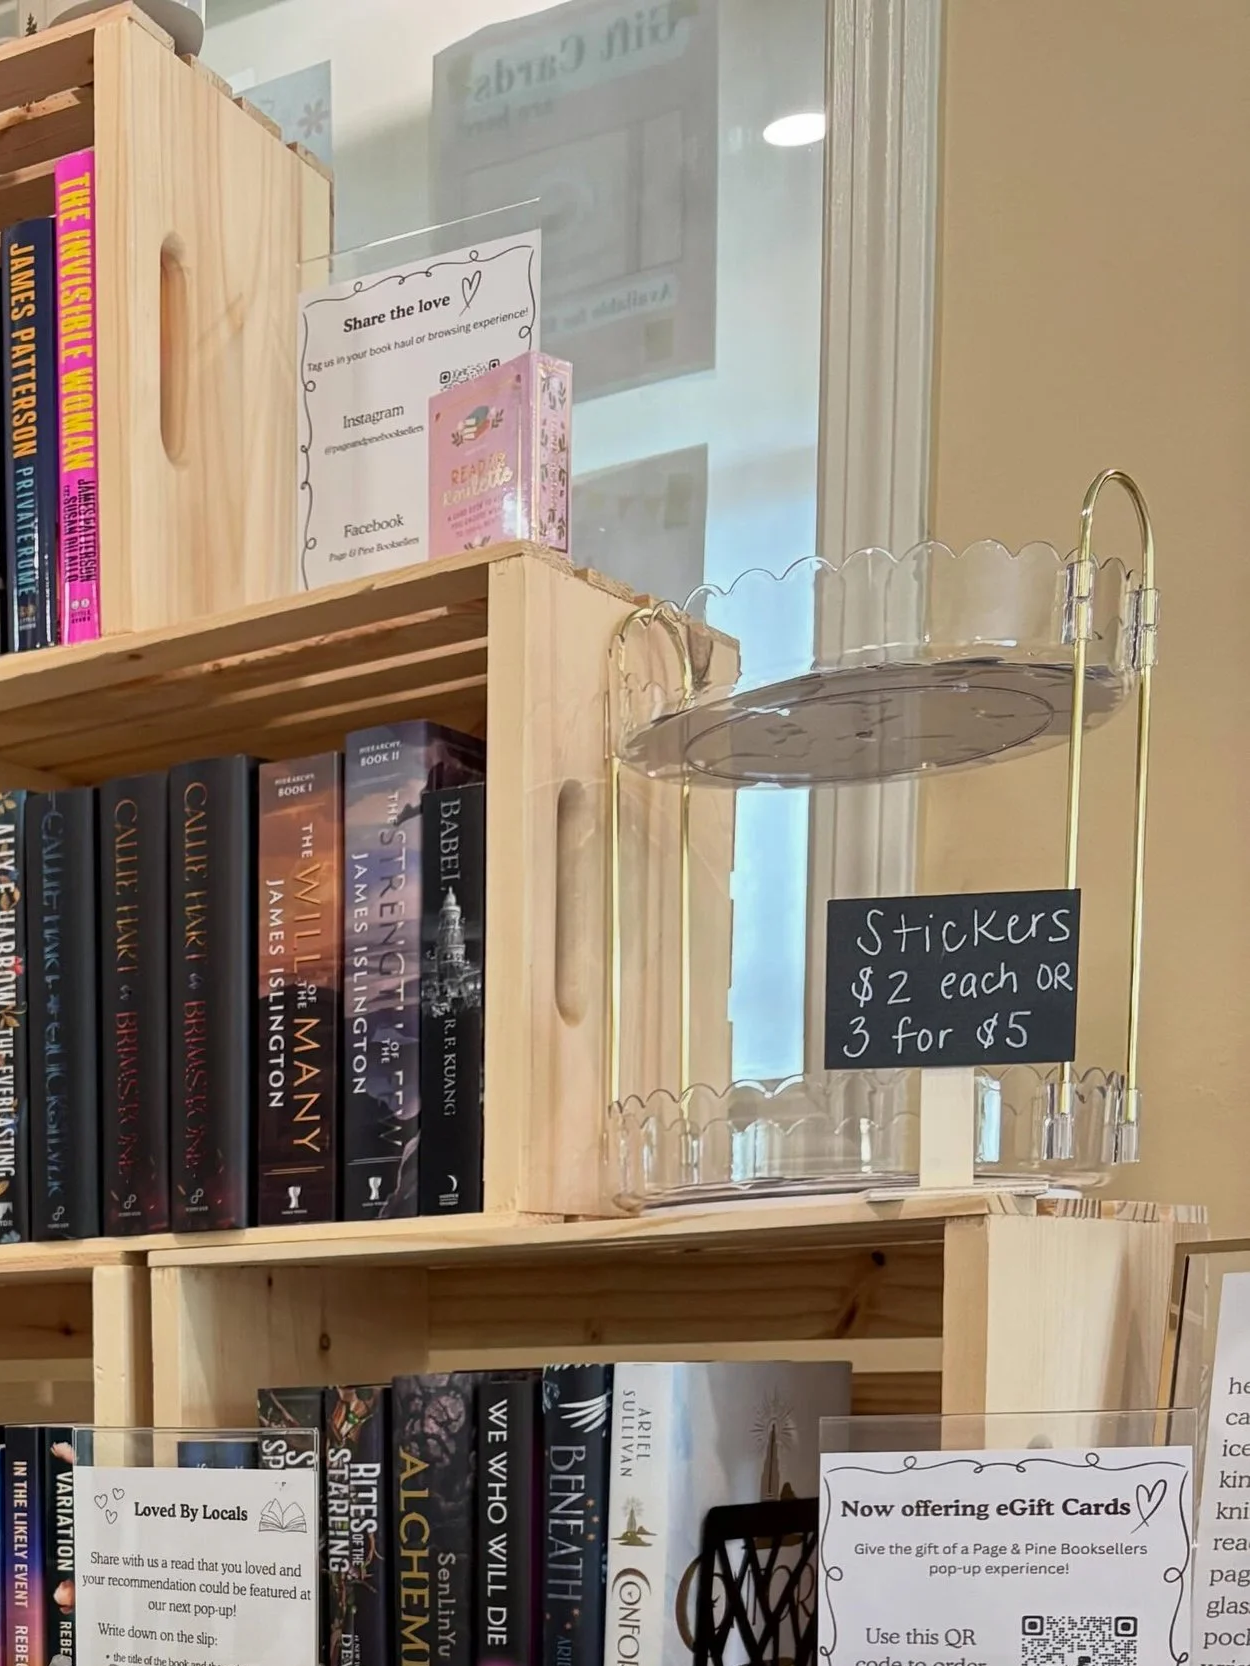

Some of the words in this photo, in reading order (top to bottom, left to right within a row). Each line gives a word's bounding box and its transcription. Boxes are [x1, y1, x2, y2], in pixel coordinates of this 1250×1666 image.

[58, 172, 91, 227] THE
[9, 243, 36, 321] JAMES
[59, 228, 93, 363] INVISIBLE
[343, 312, 386, 333] Share
[390, 304, 414, 321] the
[418, 294, 451, 313] love
[307, 362, 322, 372] Tag
[324, 359, 335, 368] us
[336, 354, 345, 365] in
[346, 350, 368, 364] your
[369, 343, 392, 357] book
[394, 336, 414, 350] haul
[415, 336, 425, 345] or
[428, 324, 472, 341] browsing
[472, 307, 529, 330] experience!
[10, 326, 39, 459] PATTERSON
[61, 366, 94, 473] WOMAN
[342, 405, 405, 429] Instagram
[344, 514, 404, 538] Facebook
[265, 879, 284, 956] JAMES
[856, 908, 1070, 956] Stickers
[940, 962, 1018, 999] each
[1036, 962, 1073, 992] OR
[267, 966, 285, 1110] ISLINGTON
[843, 1016, 870, 1058] 3
[892, 1016, 954, 1054] for
[976, 1011, 1031, 1049] $5
[487, 1398, 508, 1444] WE
[134, 1502, 176, 1518] Loved
[180, 1503, 199, 1521] By
[202, 1504, 248, 1521] Locals
[487, 1451, 508, 1525] WHO
[841, 1500, 895, 1518] Now
[901, 1499, 990, 1521] offering
[996, 1498, 1054, 1517] eGift
[1061, 1498, 1131, 1517] Cards
[55, 1471, 74, 1572] VARIATION
[547, 1443, 586, 1602] BENEATH
[90, 1551, 120, 1567] Share
[122, 1554, 144, 1568] with
[147, 1558, 160, 1568] us
[170, 1557, 195, 1570] read
[197, 1558, 219, 1573] that
[221, 1563, 242, 1576] you
[245, 1561, 276, 1576] loved
[279, 1563, 302, 1578] and
[487, 1533, 508, 1598] WILL
[854, 1543, 886, 1556] Give
[889, 1543, 912, 1556] the
[915, 1543, 939, 1559] gift
[942, 1543, 960, 1556] of
[961, 1547, 970, 1556] a
[973, 1544, 1008, 1559] Page
[1011, 1544, 1021, 1556] &
[1025, 1543, 1057, 1556] Pine
[1061, 1543, 1148, 1557] Booksellers
[929, 1564, 982, 1578] pop-up
[985, 1563, 1070, 1578] experience!
[98, 1622, 126, 1637] Write
[127, 1626, 158, 1640] down
[160, 1631, 175, 1642] on
[177, 1631, 195, 1644] the
[196, 1632, 218, 1647] slip:
[487, 1605, 508, 1647] DIE
[865, 1628, 902, 1646] Use
[905, 1627, 939, 1646] this
[944, 1629, 978, 1648] QR
